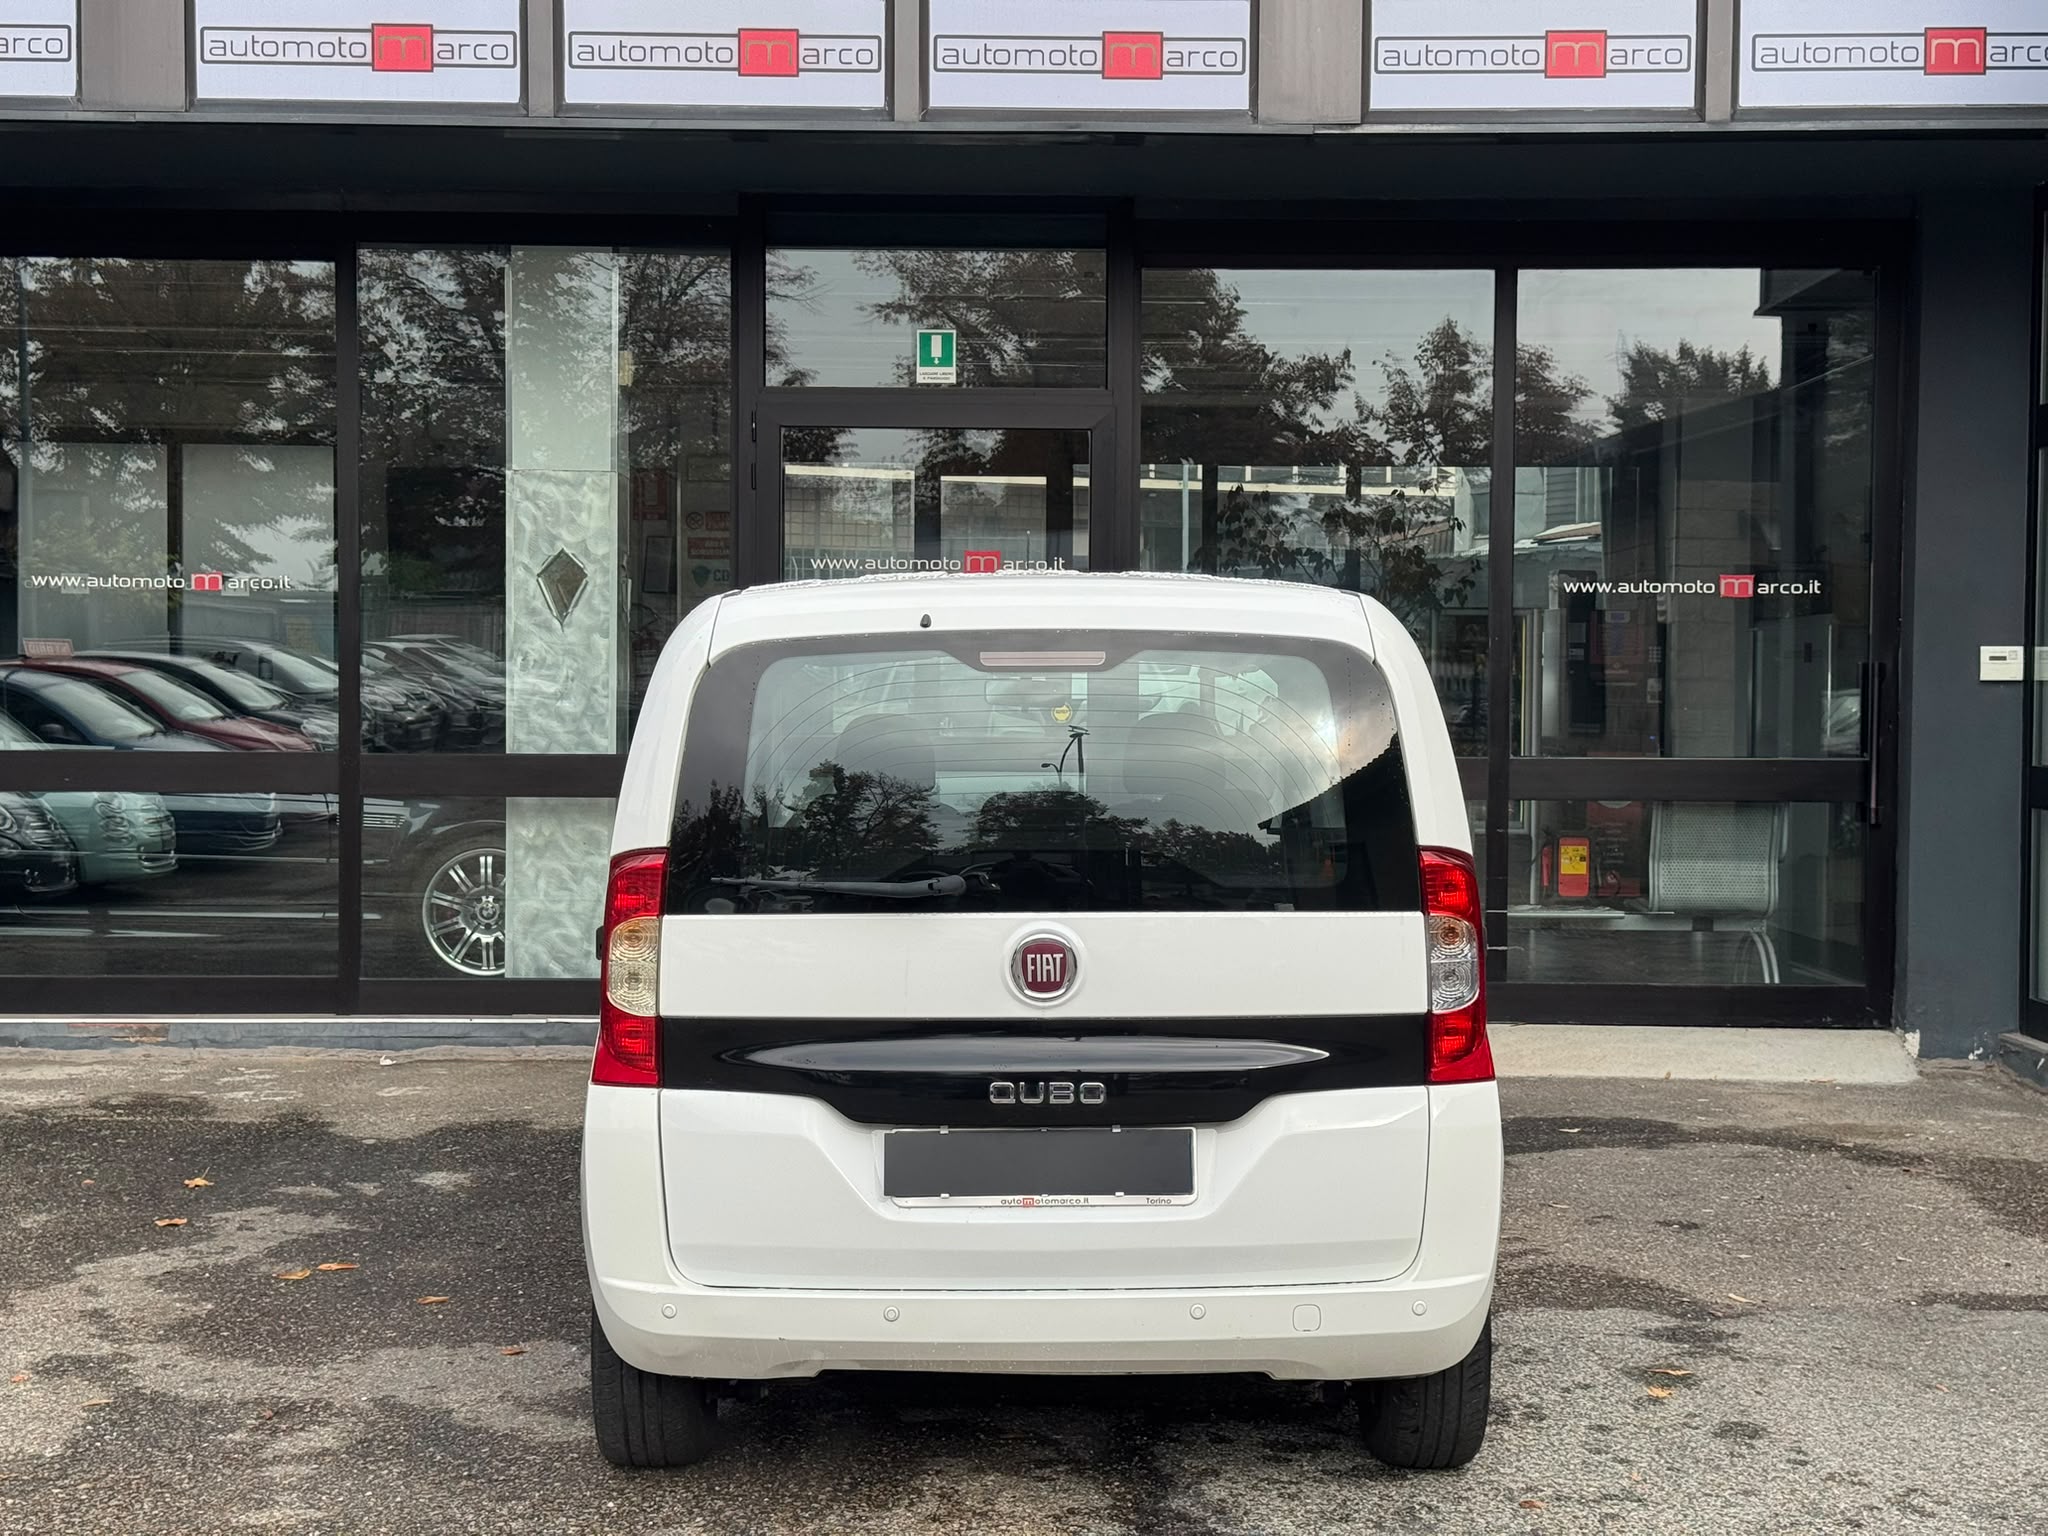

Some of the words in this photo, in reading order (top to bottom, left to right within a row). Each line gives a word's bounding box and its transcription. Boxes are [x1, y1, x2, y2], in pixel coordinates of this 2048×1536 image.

[1026, 953, 1064, 983] FIAT
[989, 1081, 1106, 1105] QUBO
[1145, 1196, 1172, 1206] Torino
